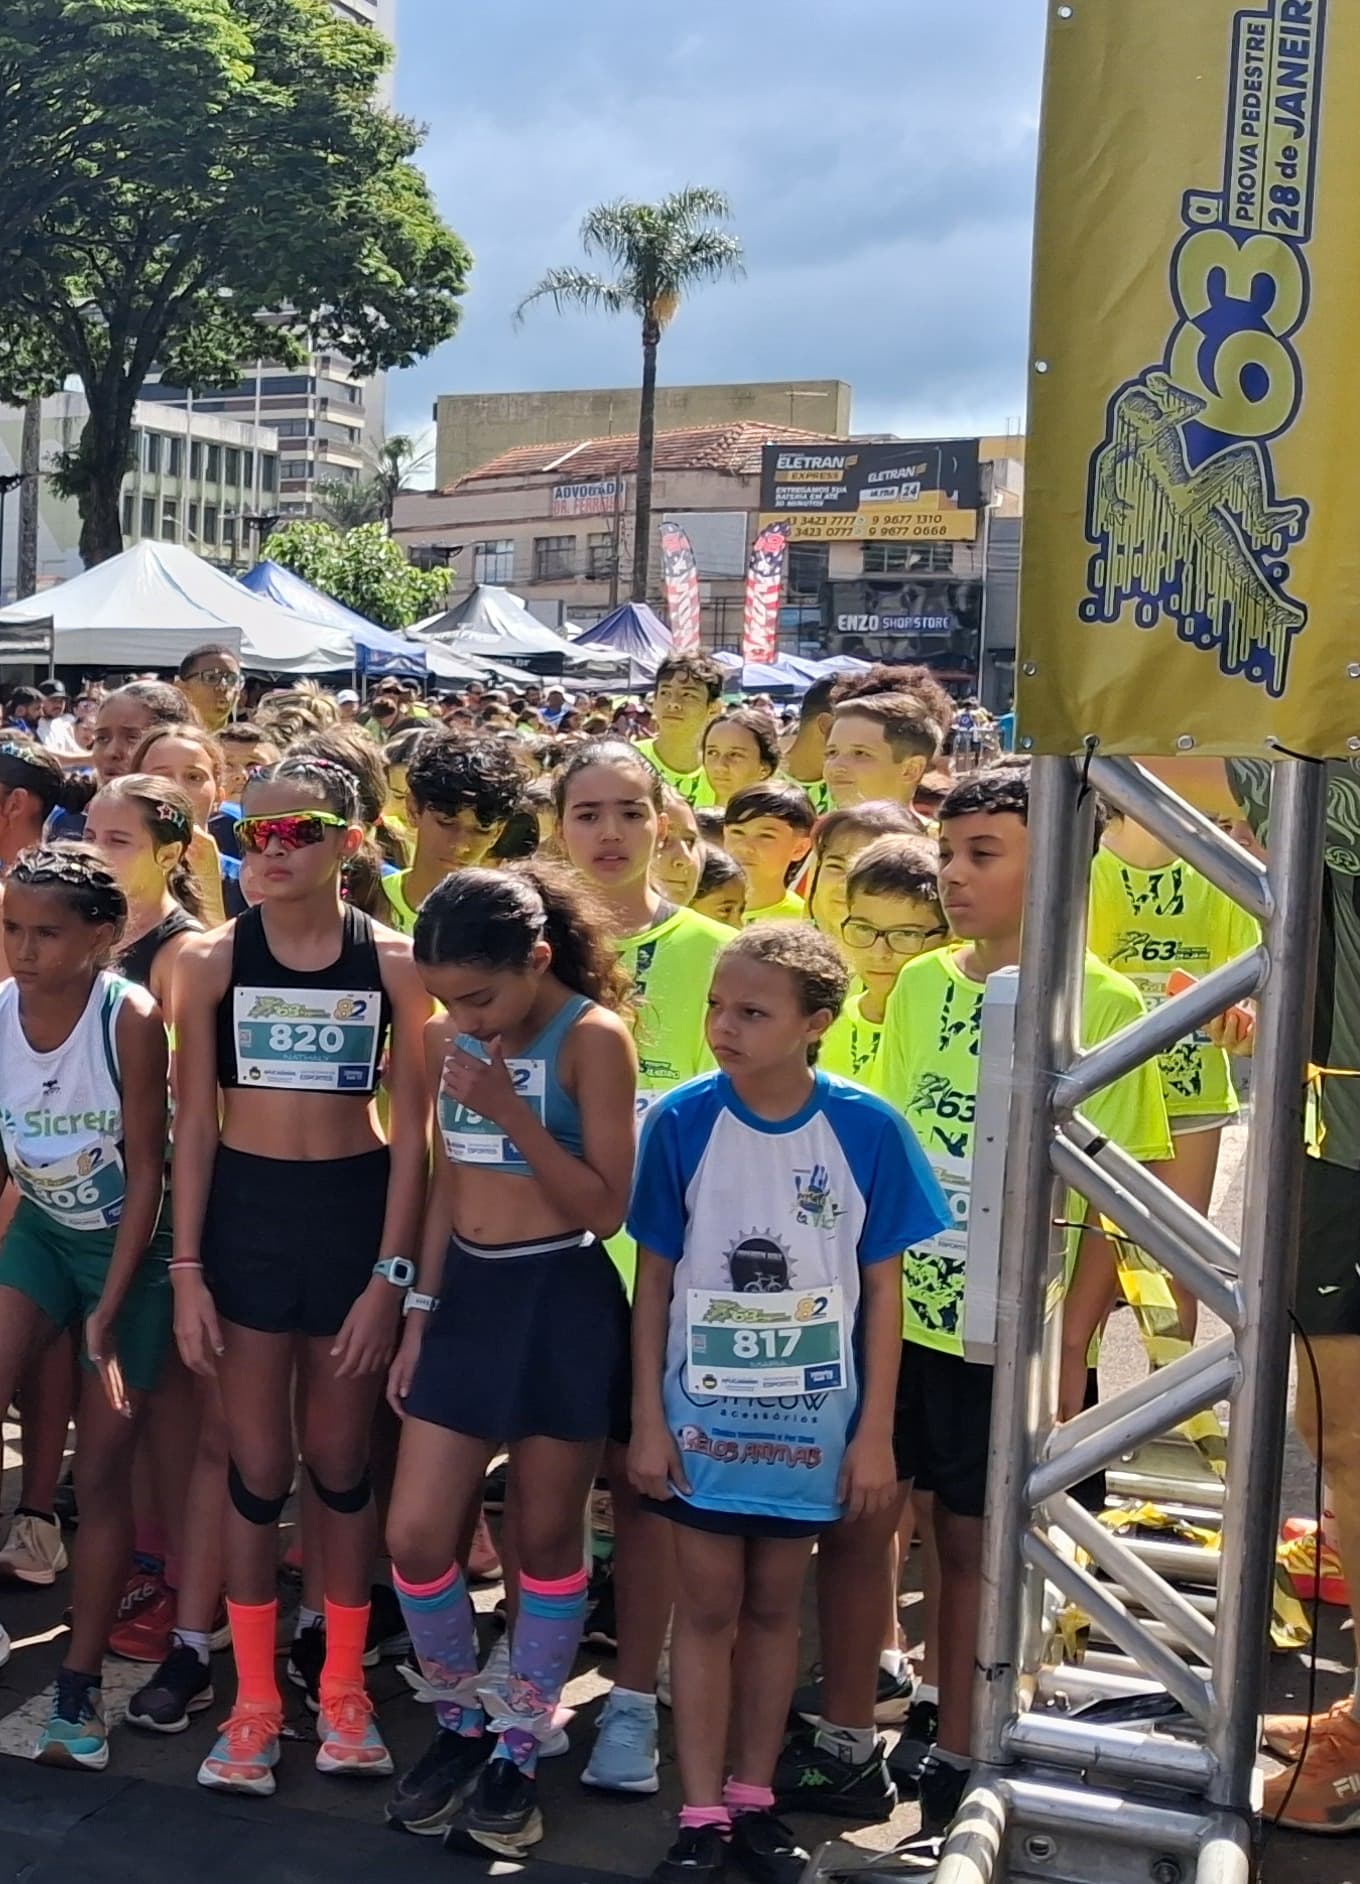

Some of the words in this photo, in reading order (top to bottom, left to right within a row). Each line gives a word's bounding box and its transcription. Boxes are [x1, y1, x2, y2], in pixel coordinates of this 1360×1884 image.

[1241, 22, 1267, 138] PEDESTRE
[1283, 144, 1299, 180] de
[1236, 142, 1260, 222] PROVA
[1268, 185, 1300, 230] 28
[776, 456, 845, 469] ELETRAN
[868, 465, 916, 483] ELETRAN
[795, 527, 822, 537] 3423
[868, 527, 876, 536] 9
[913, 526, 947, 536] 0668
[800, 516, 828, 525] 3423
[830, 515, 856, 525] 7777
[872, 515, 880, 524] 9
[916, 515, 942, 525] 1310
[838, 614, 879, 631] ENZO
[1141, 940, 1177, 961] 63
[334, 999, 367, 1020] 82
[268, 1023, 345, 1054] 820
[936, 1090, 977, 1123] 63
[794, 1296, 829, 1322] 82
[733, 1328, 802, 1359] 817
[720, 1408, 818, 1424] acessórios
